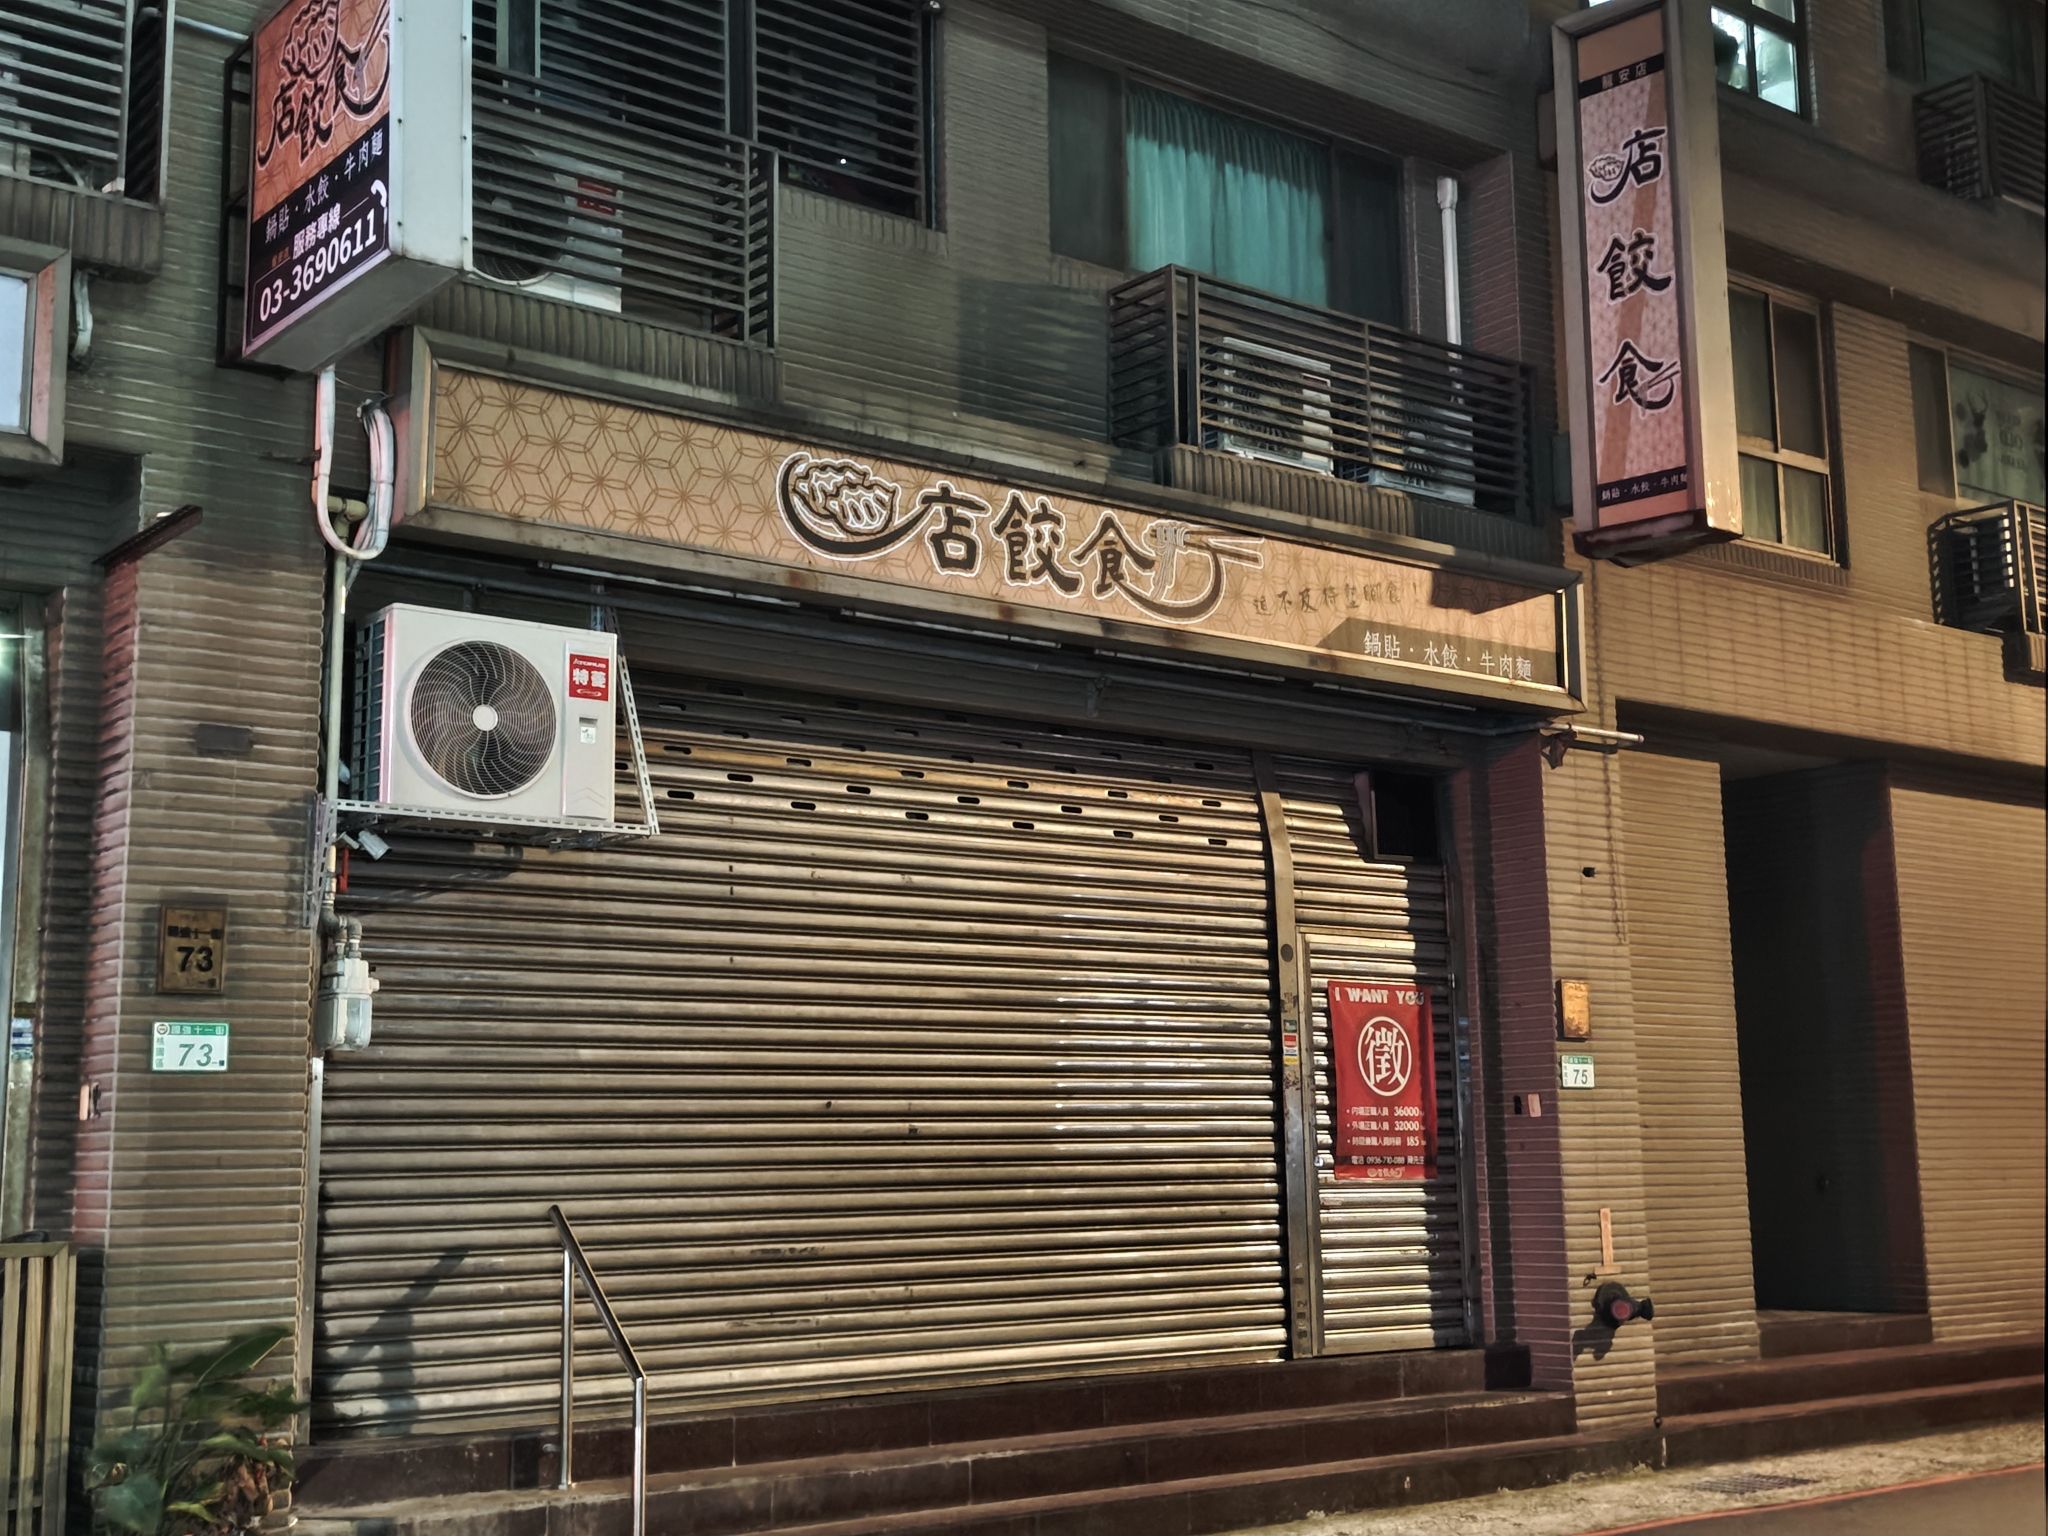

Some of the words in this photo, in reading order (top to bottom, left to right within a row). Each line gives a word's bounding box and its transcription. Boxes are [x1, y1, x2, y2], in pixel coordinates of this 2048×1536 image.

[259, 207, 377, 322] 03-3690611
[1363, 629, 1400, 659] 鍋貼
[1424, 639, 1459, 669] 水餃
[1480, 650, 1532, 681] 牛肉麵
[177, 946, 213, 972] 73
[1334, 986, 1341, 1002] I
[1344, 987, 1389, 1004] WANT
[1395, 990, 1424, 1006] YOU
[179, 1043, 213, 1067] 73
[1364, 1026, 1405, 1086] 徵
[1573, 1069, 1588, 1085] 75
[1394, 1106, 1420, 1117] 36000
[1394, 1120, 1420, 1131] 32000
[1406, 1135, 1420, 1147] 185
